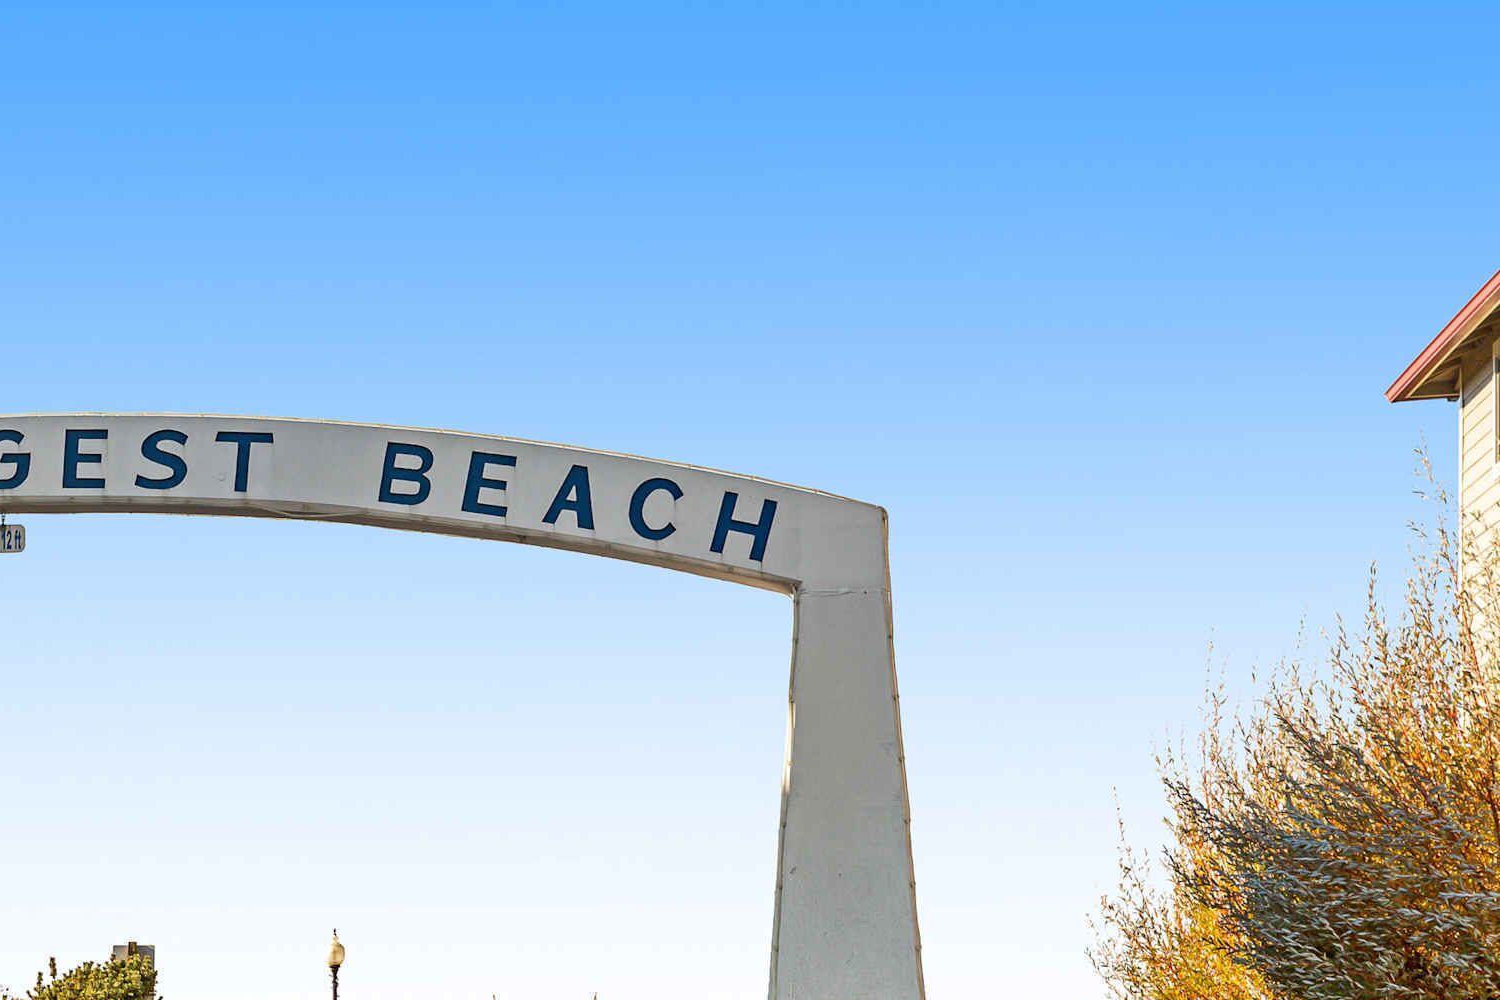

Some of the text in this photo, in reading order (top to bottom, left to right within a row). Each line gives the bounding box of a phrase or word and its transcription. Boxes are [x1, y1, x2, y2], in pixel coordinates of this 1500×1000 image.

[378, 442, 778, 563] BEACH
[1, 530, 12, 550] 12
[14, 529, 22, 550] ft
